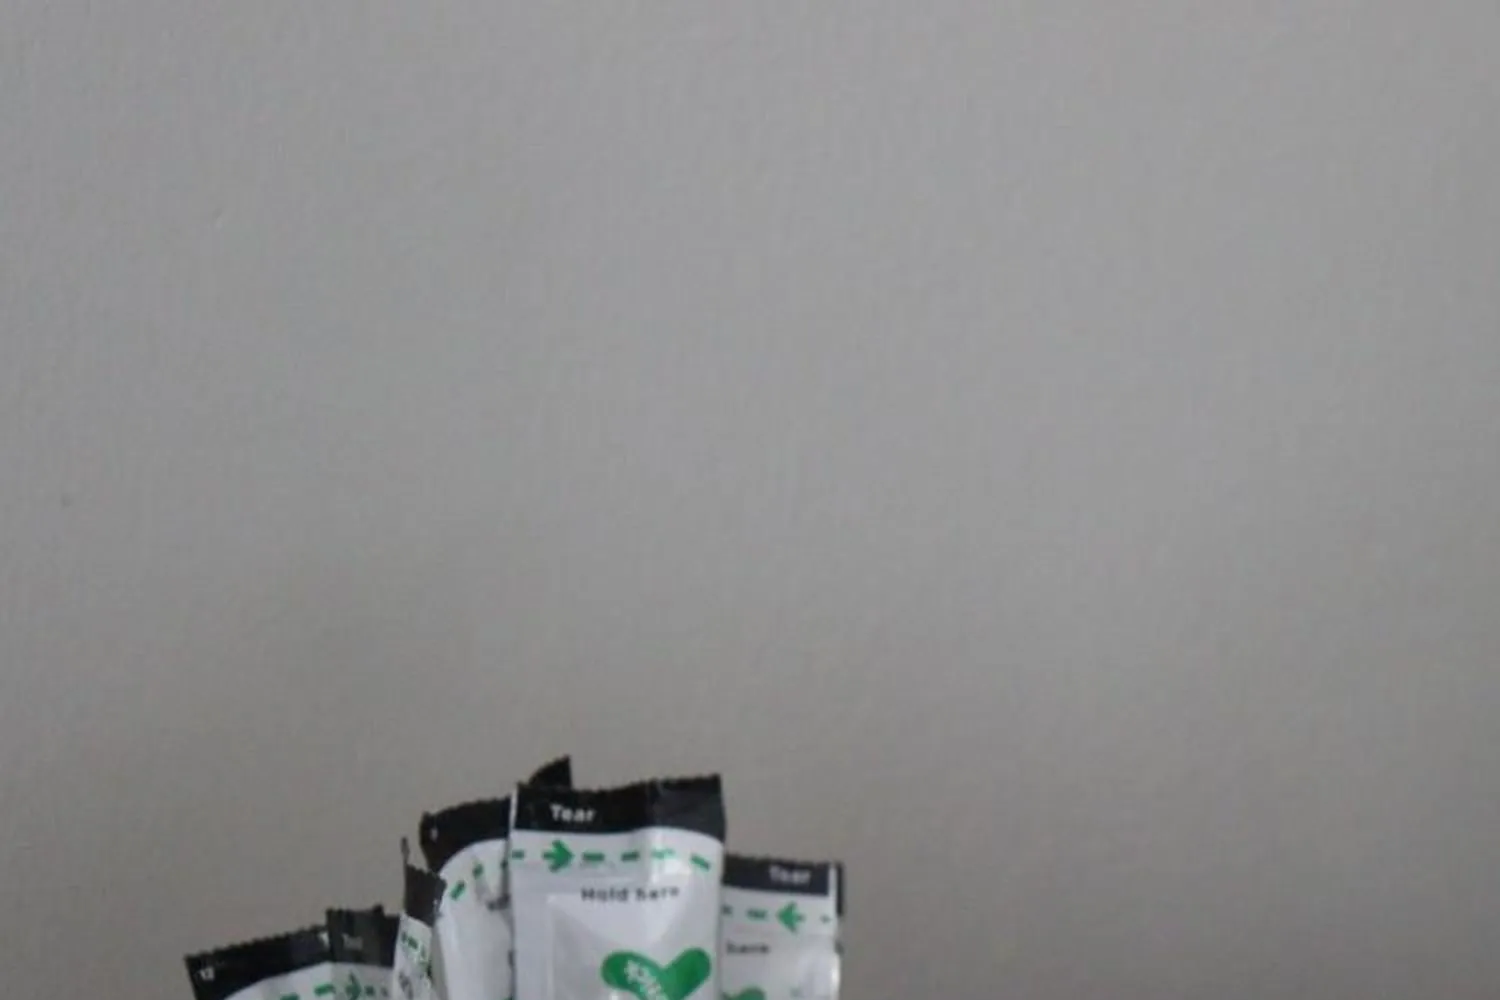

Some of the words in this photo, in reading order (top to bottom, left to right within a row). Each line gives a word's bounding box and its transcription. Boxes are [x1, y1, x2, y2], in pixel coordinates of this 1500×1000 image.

[550, 803, 598, 823] Tear
[769, 864, 812, 884] Tear
[581, 886, 629, 902] Hold
[636, 885, 680, 901] here
